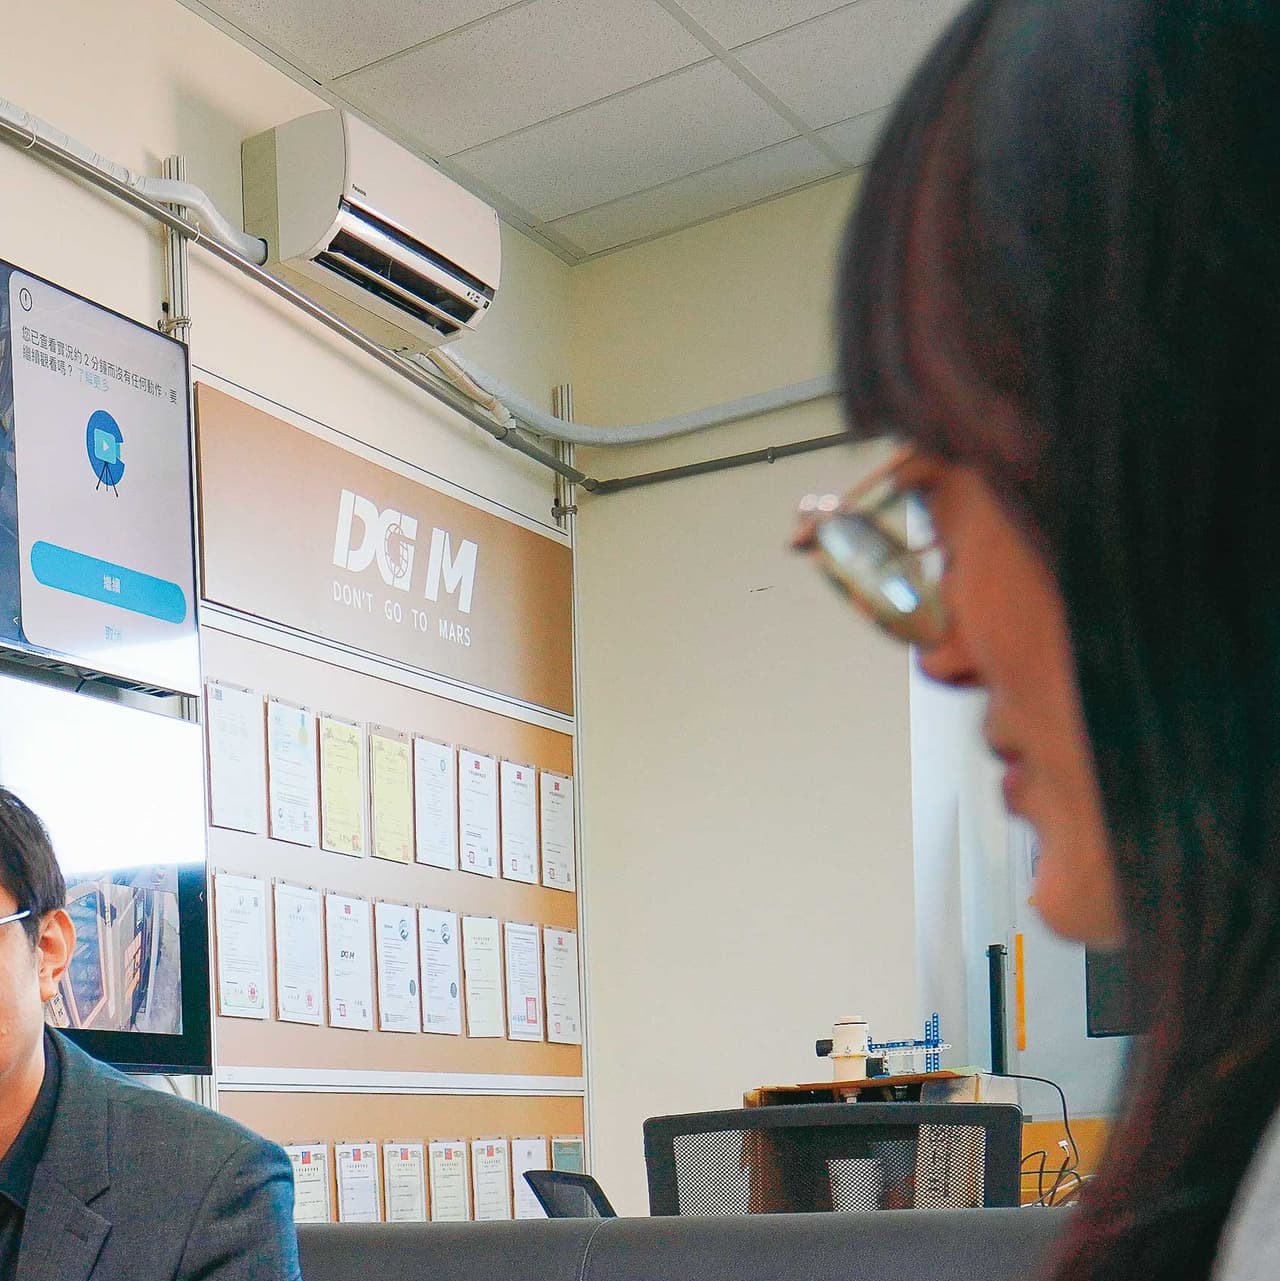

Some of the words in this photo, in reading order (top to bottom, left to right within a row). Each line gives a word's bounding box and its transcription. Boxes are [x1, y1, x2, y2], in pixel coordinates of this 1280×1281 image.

[332, 580, 373, 613] DON'T
[384, 598, 403, 623] GO
[412, 608, 428, 633] TO
[439, 618, 472, 648] MARS
